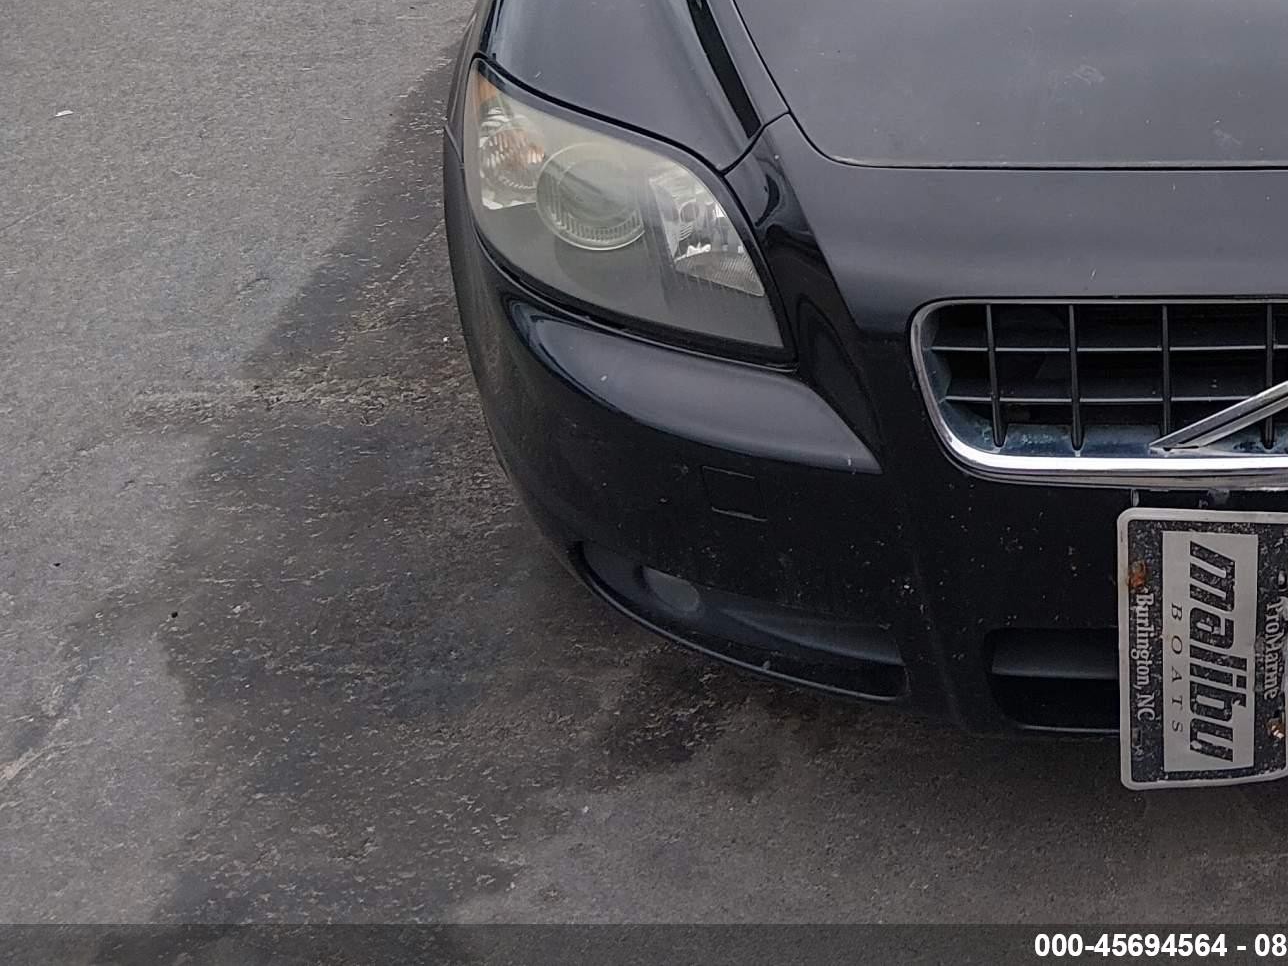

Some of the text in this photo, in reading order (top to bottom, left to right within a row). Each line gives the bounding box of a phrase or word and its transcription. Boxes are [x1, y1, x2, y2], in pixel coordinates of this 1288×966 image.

[1131, 592, 1156, 722] Burlington, NC
[1171, 604, 1183, 733] BOATS
[1189, 540, 1248, 763] malibu
